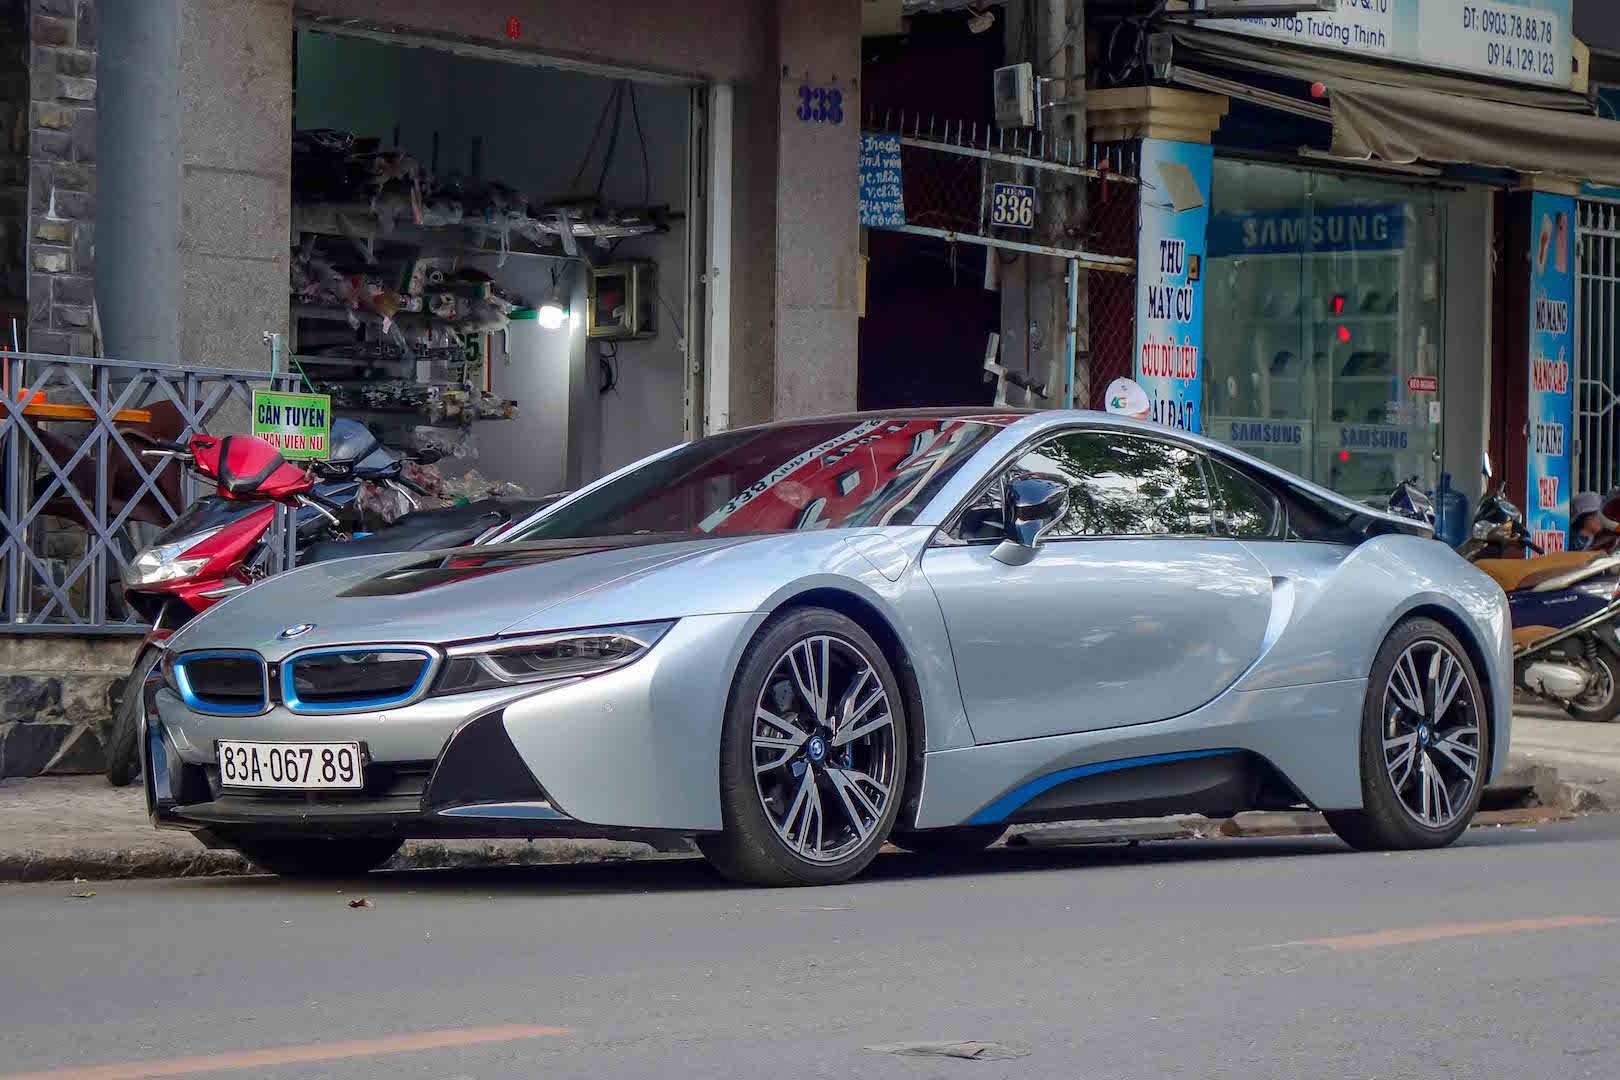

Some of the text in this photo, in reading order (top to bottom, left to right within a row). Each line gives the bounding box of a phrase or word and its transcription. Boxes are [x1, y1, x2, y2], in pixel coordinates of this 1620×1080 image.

[1463, 6, 1552, 44] ĐT: 0903.78.88.78
[1487, 42, 1554, 75] 0914.129.123
[796, 87, 844, 124] 338
[994, 193, 1033, 225] 336
[1242, 215, 1388, 248] SAMSUNG
[1160, 240, 1184, 274] THU
[1148, 276, 1174, 319] MÁY
[258, 398, 324, 427] CẦN TUYỂN
[1110, 396, 1127, 409] 4G
[1231, 422, 1302, 444] SAMSUNG
[1340, 427, 1408, 448] SAMSUNG
[1540, 478, 1556, 508] THAY
